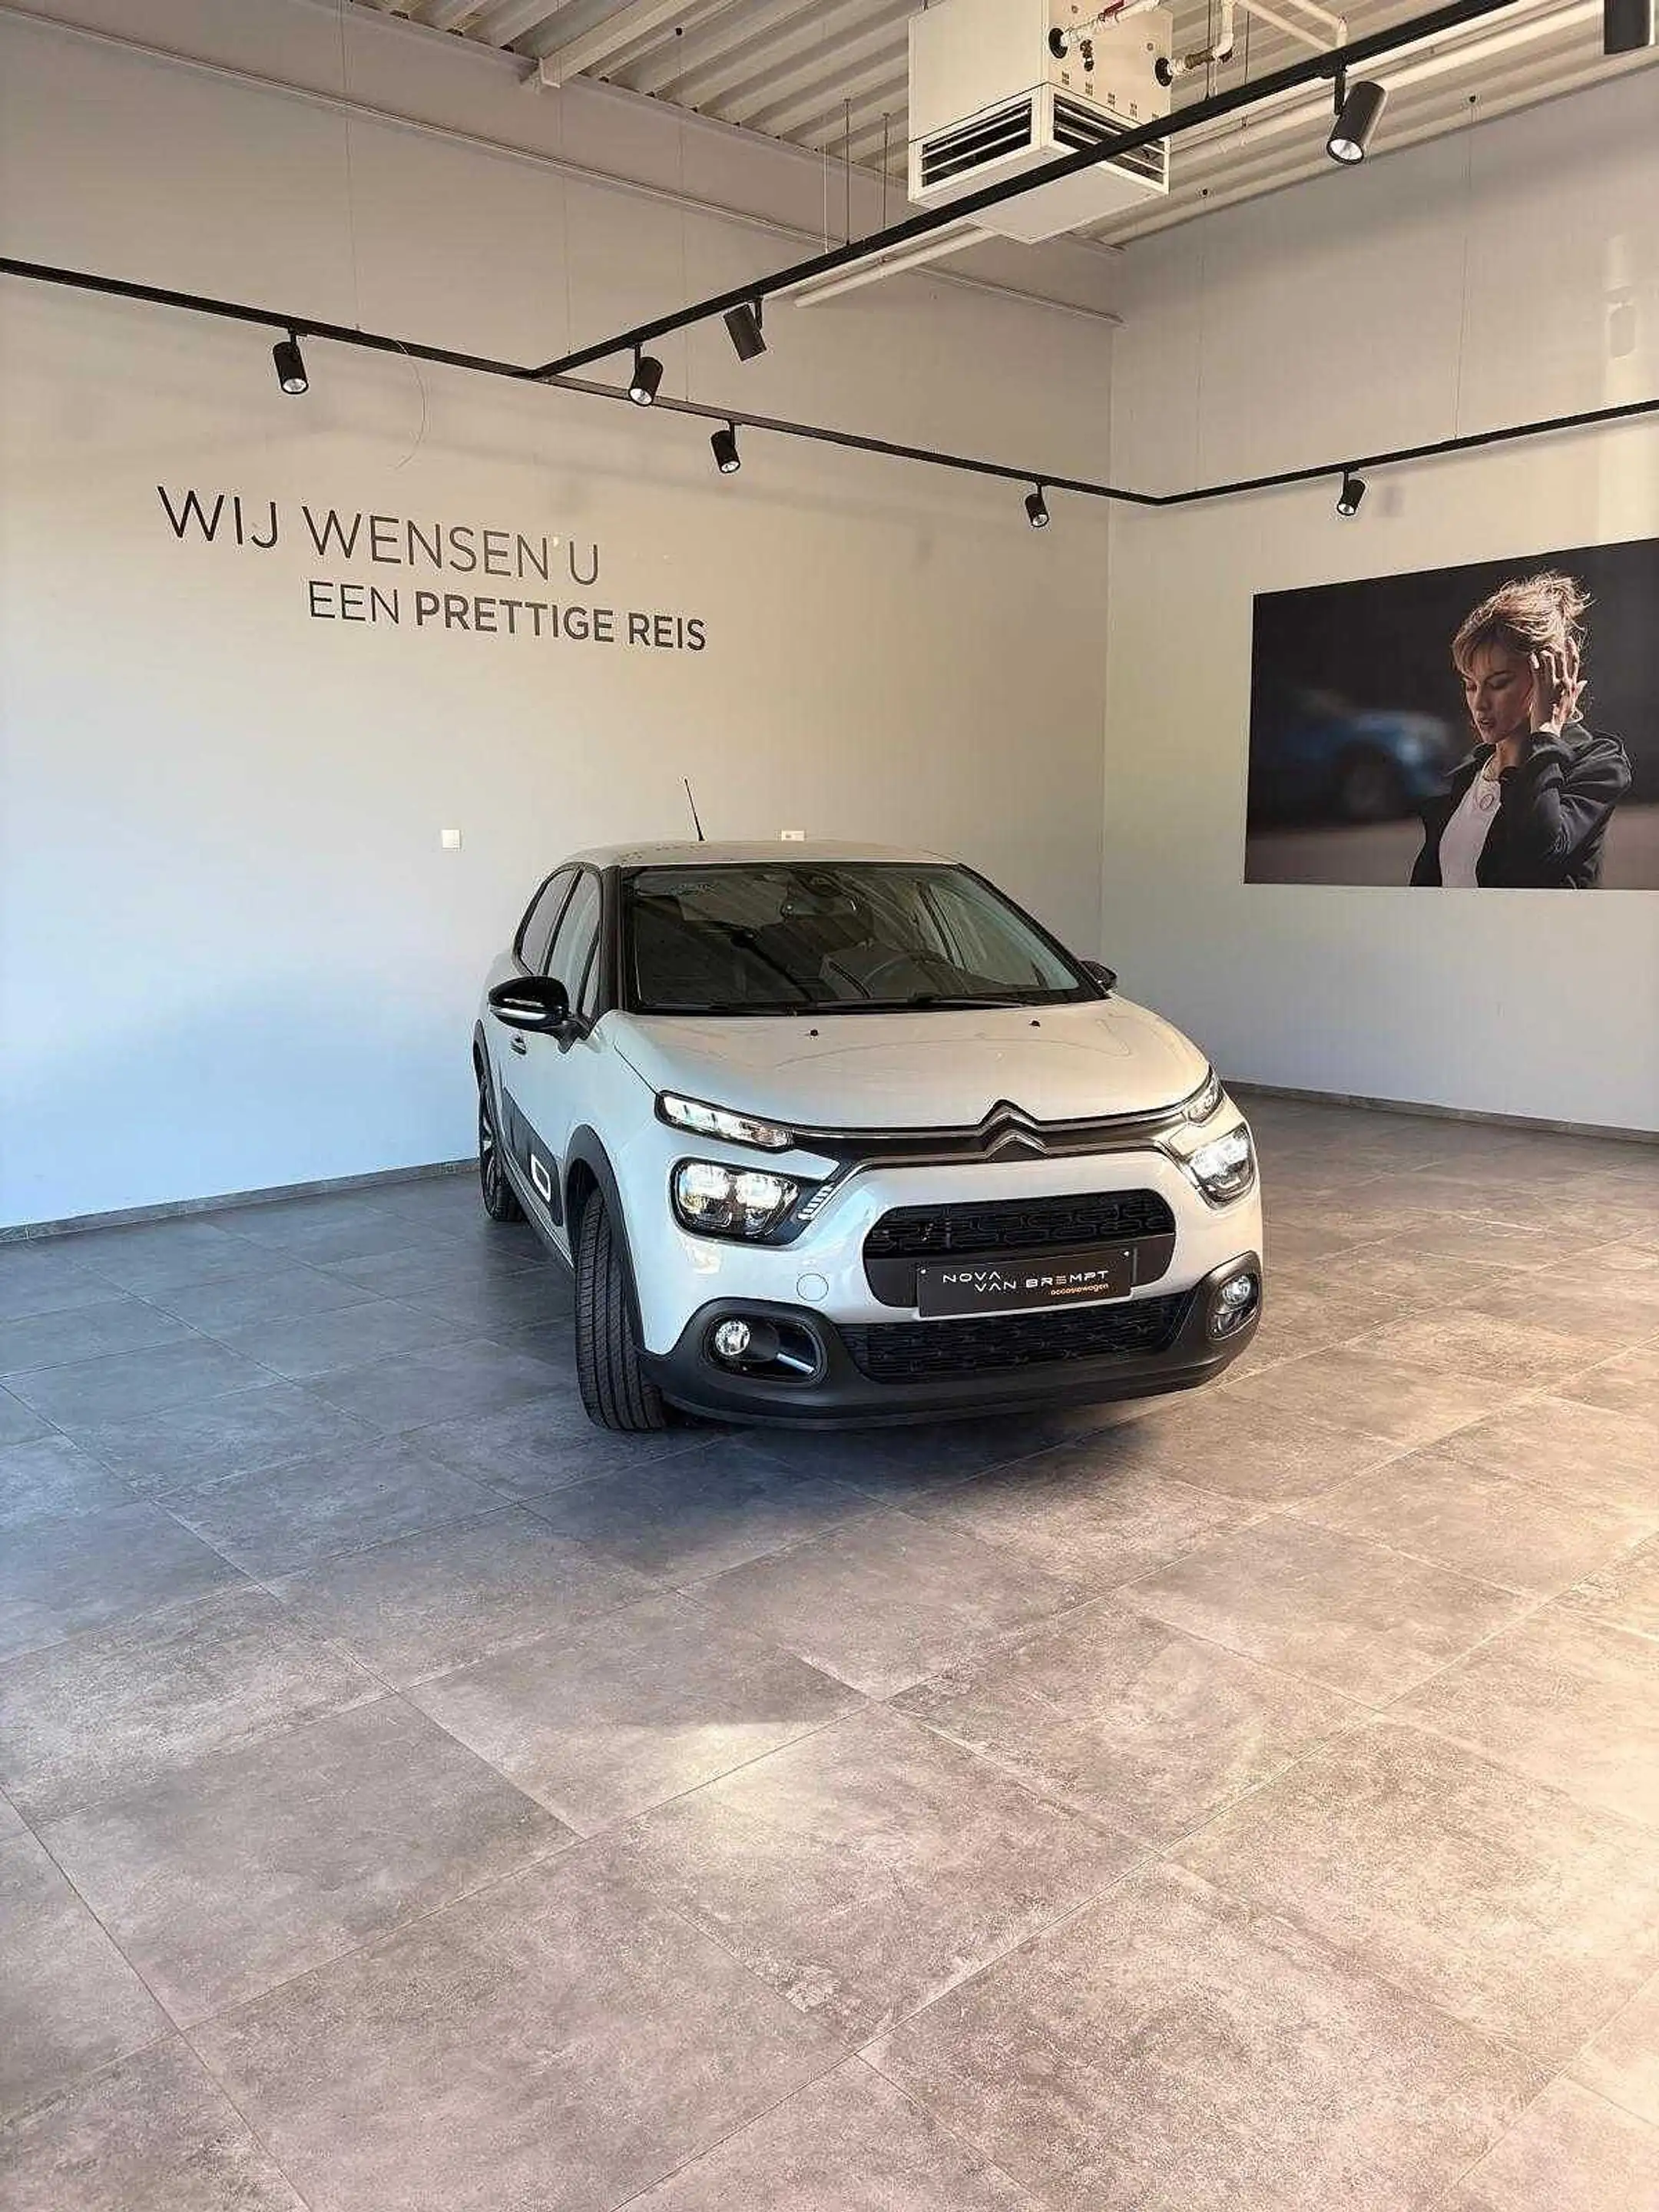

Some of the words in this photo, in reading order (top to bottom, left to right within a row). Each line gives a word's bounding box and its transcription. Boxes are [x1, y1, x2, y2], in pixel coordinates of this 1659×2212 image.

[157, 486, 277, 548] WIJ
[301, 506, 548, 581] WENSEN
[570, 541, 598, 585] U
[309, 581, 399, 624] EEN
[416, 591, 614, 642] PRETTIGE
[628, 612, 706, 651] REIS
[942, 1271, 1001, 1283] NOVA
[975, 1281, 1017, 1293] VAN
[1025, 1270, 1109, 1289] BREMPT
